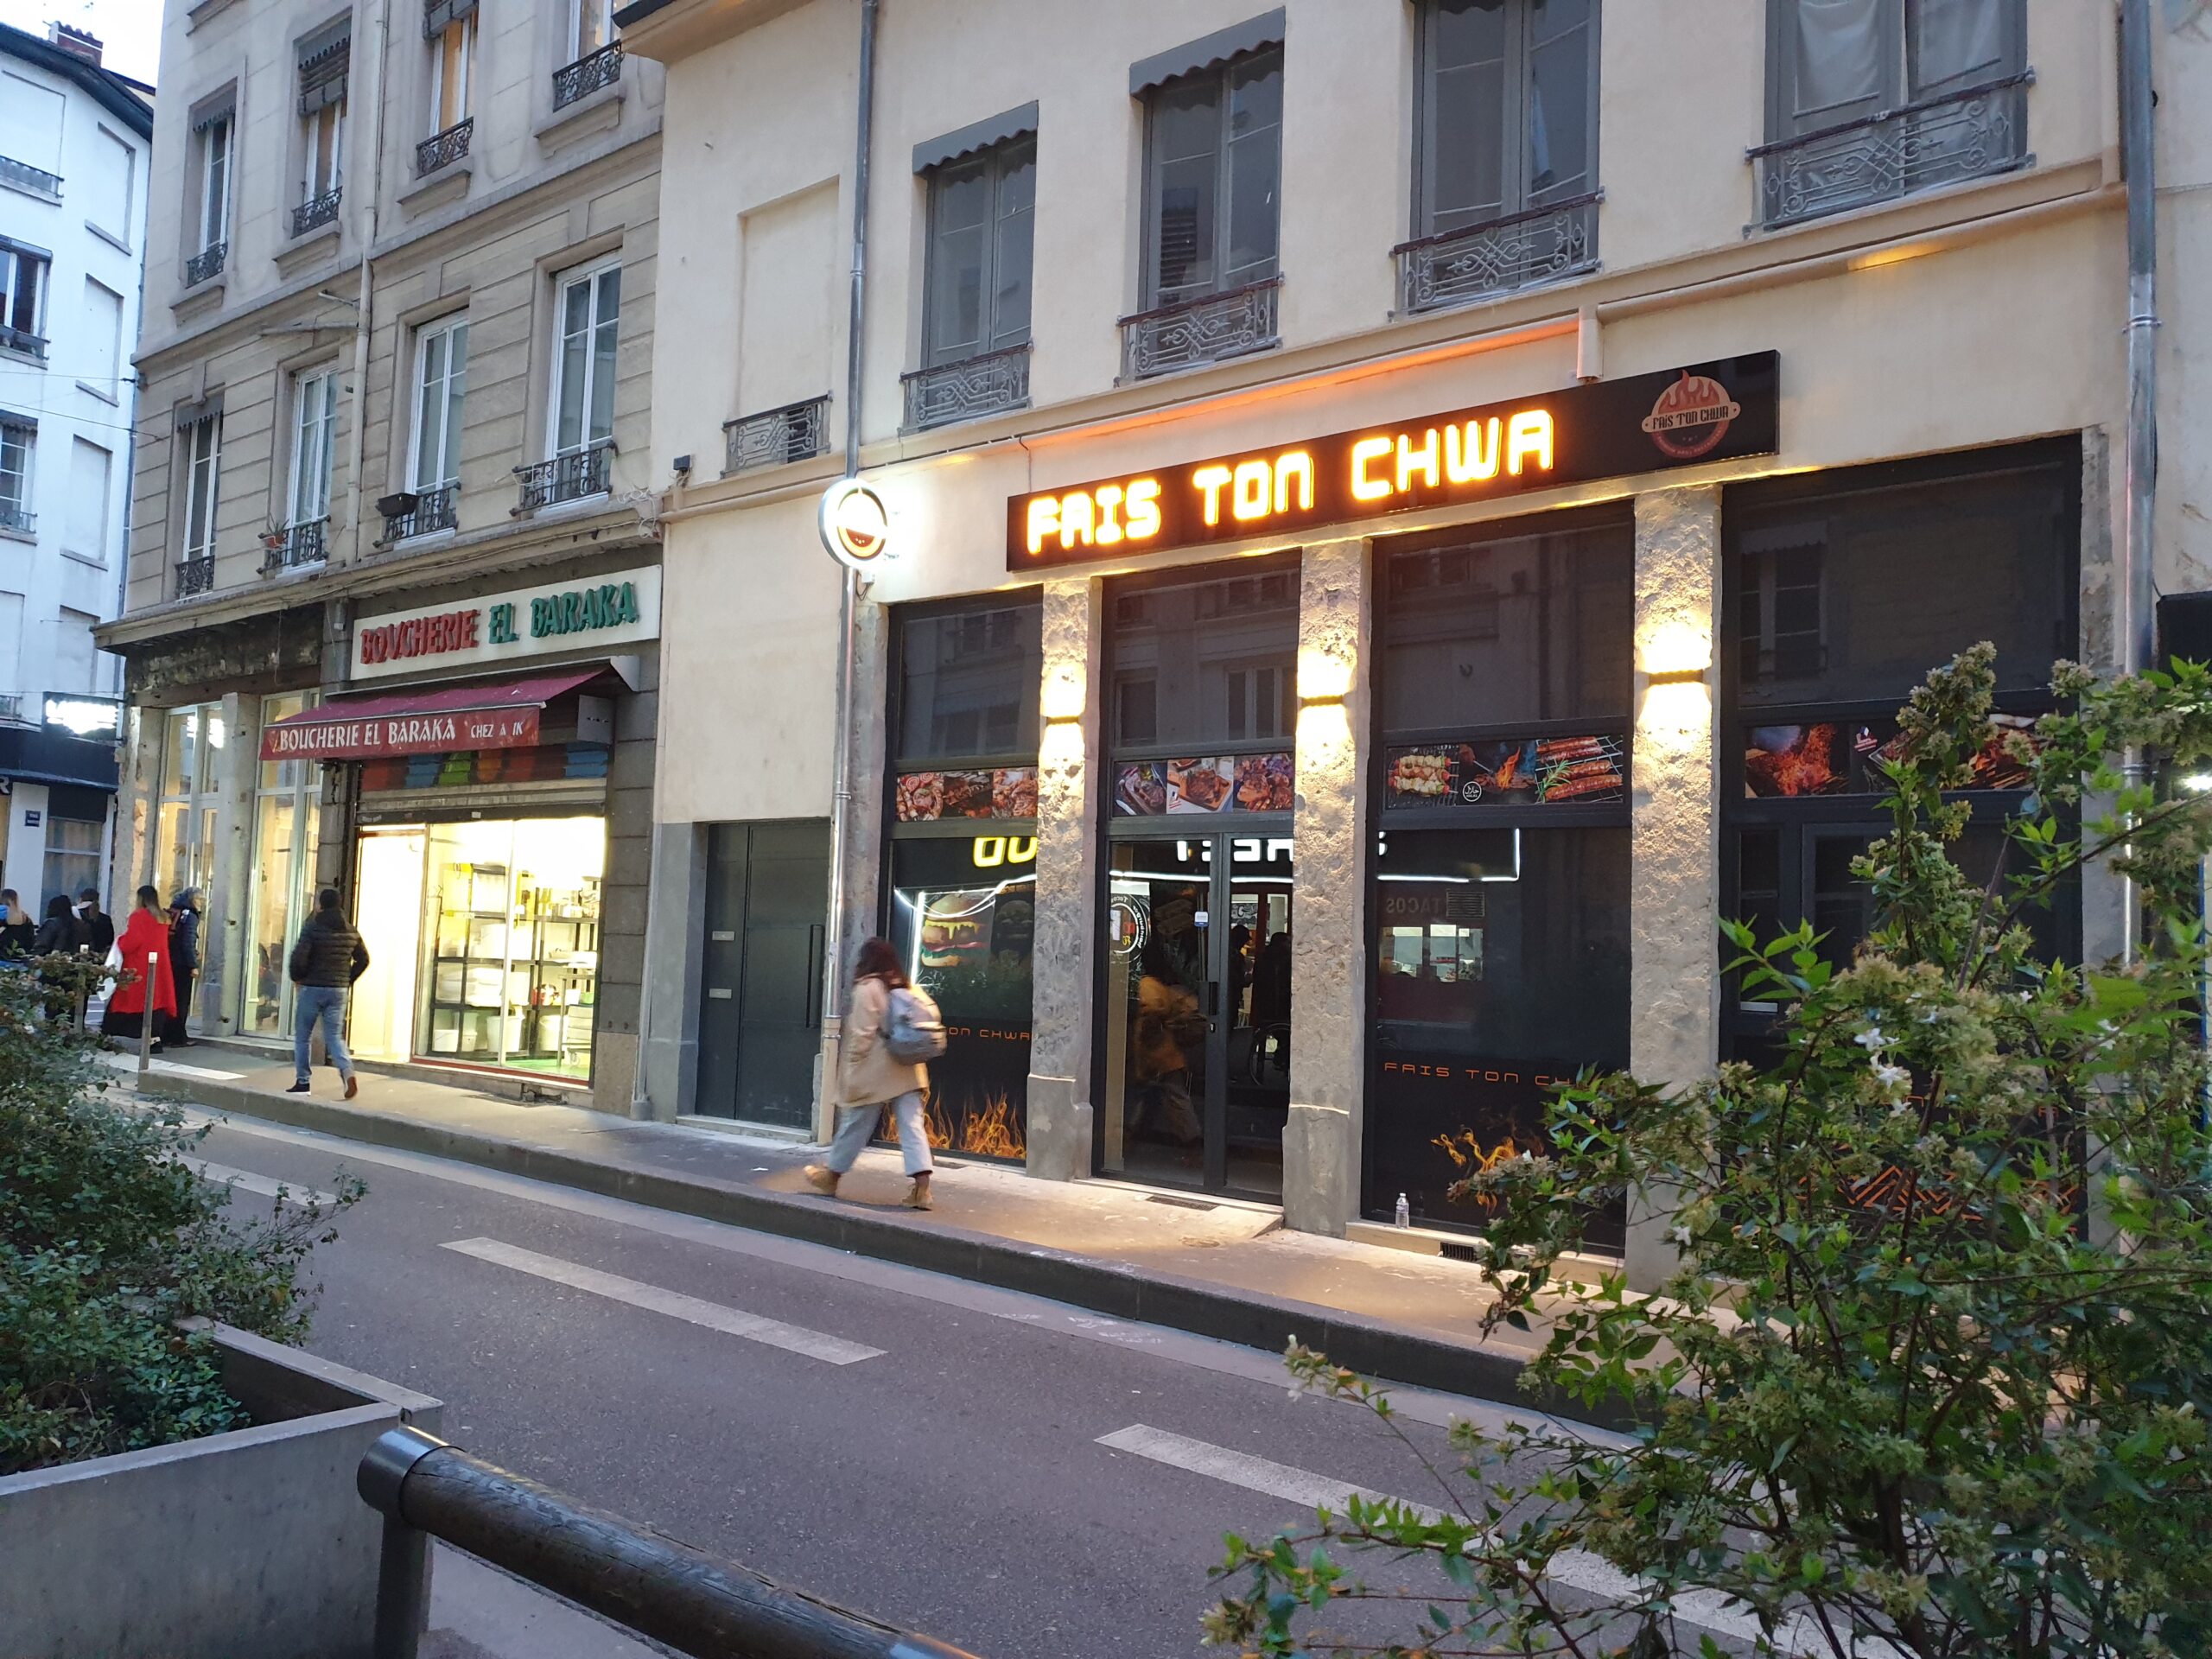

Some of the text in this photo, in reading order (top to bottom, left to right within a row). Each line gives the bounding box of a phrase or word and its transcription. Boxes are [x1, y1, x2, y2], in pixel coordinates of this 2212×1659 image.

[1676, 411, 1698, 426] TON
[1700, 405, 1729, 422] CHWA
[1026, 409, 1556, 556] FAIS TON CHWA
[359, 581, 639, 664] BOUCHERIE EL BARAKA
[279, 724, 359, 752] BOUCHERIE
[364, 722, 381, 747] EL
[388, 717, 456, 745] BARAKA
[470, 723, 495, 739] CHEZ
[948, 1027, 1031, 1040] ON CHWA
[1384, 1062, 1450, 1077] FAIS
[1465, 1069, 1519, 1084] TON
